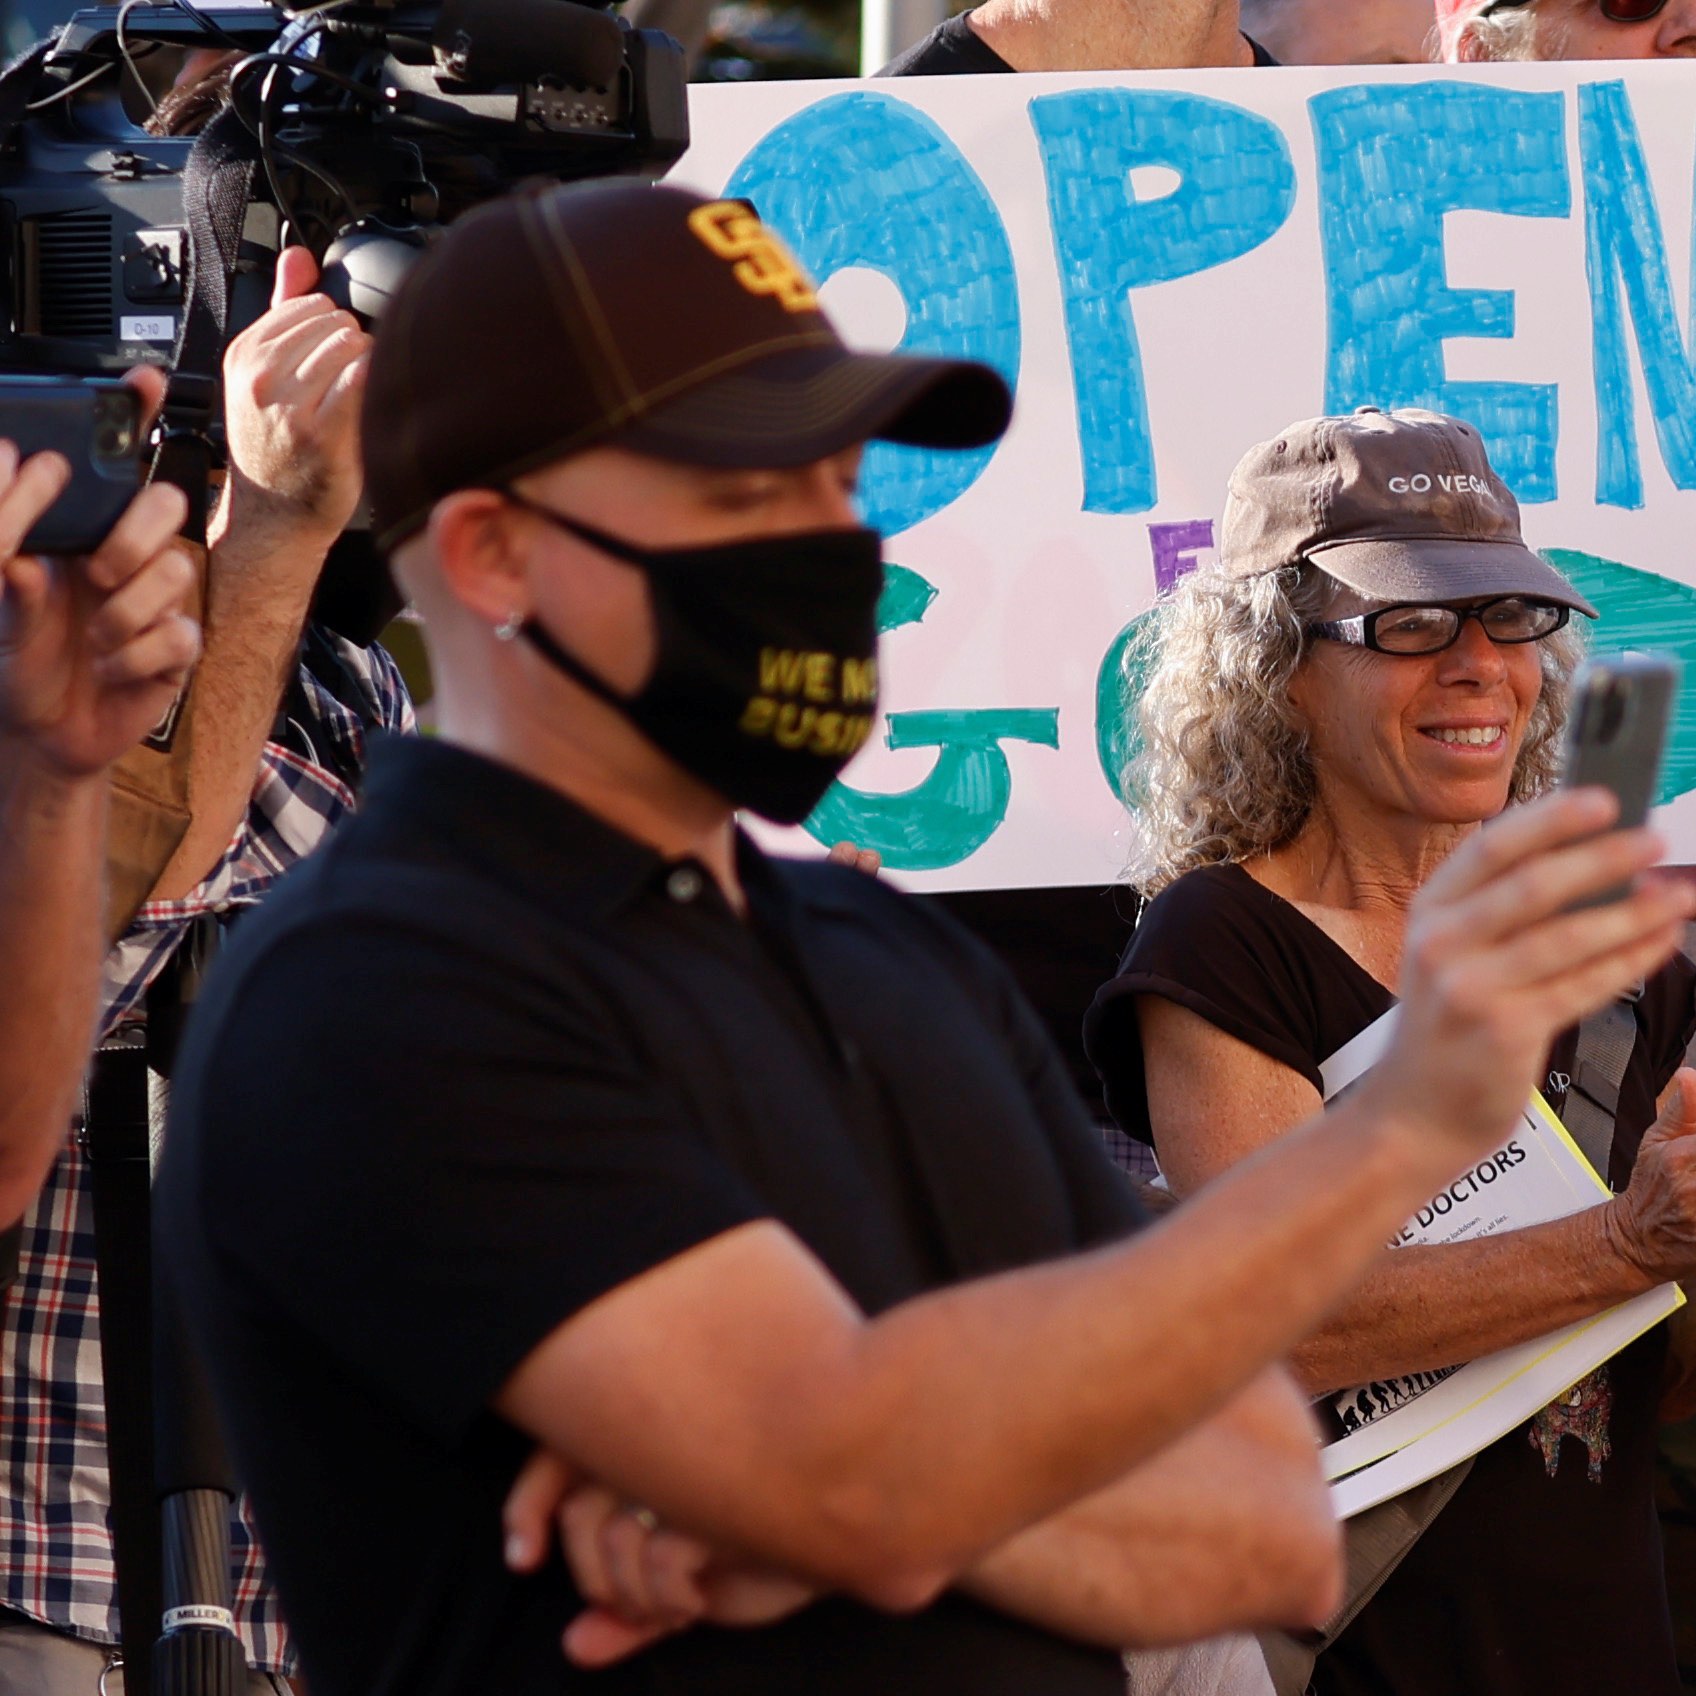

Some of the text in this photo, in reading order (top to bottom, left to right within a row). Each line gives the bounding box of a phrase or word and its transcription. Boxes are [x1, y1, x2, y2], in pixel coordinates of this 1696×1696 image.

[1388, 473, 1432, 493] GO
[760, 648, 834, 700] WE
[1415, 1140, 1527, 1229] DOCTORS
